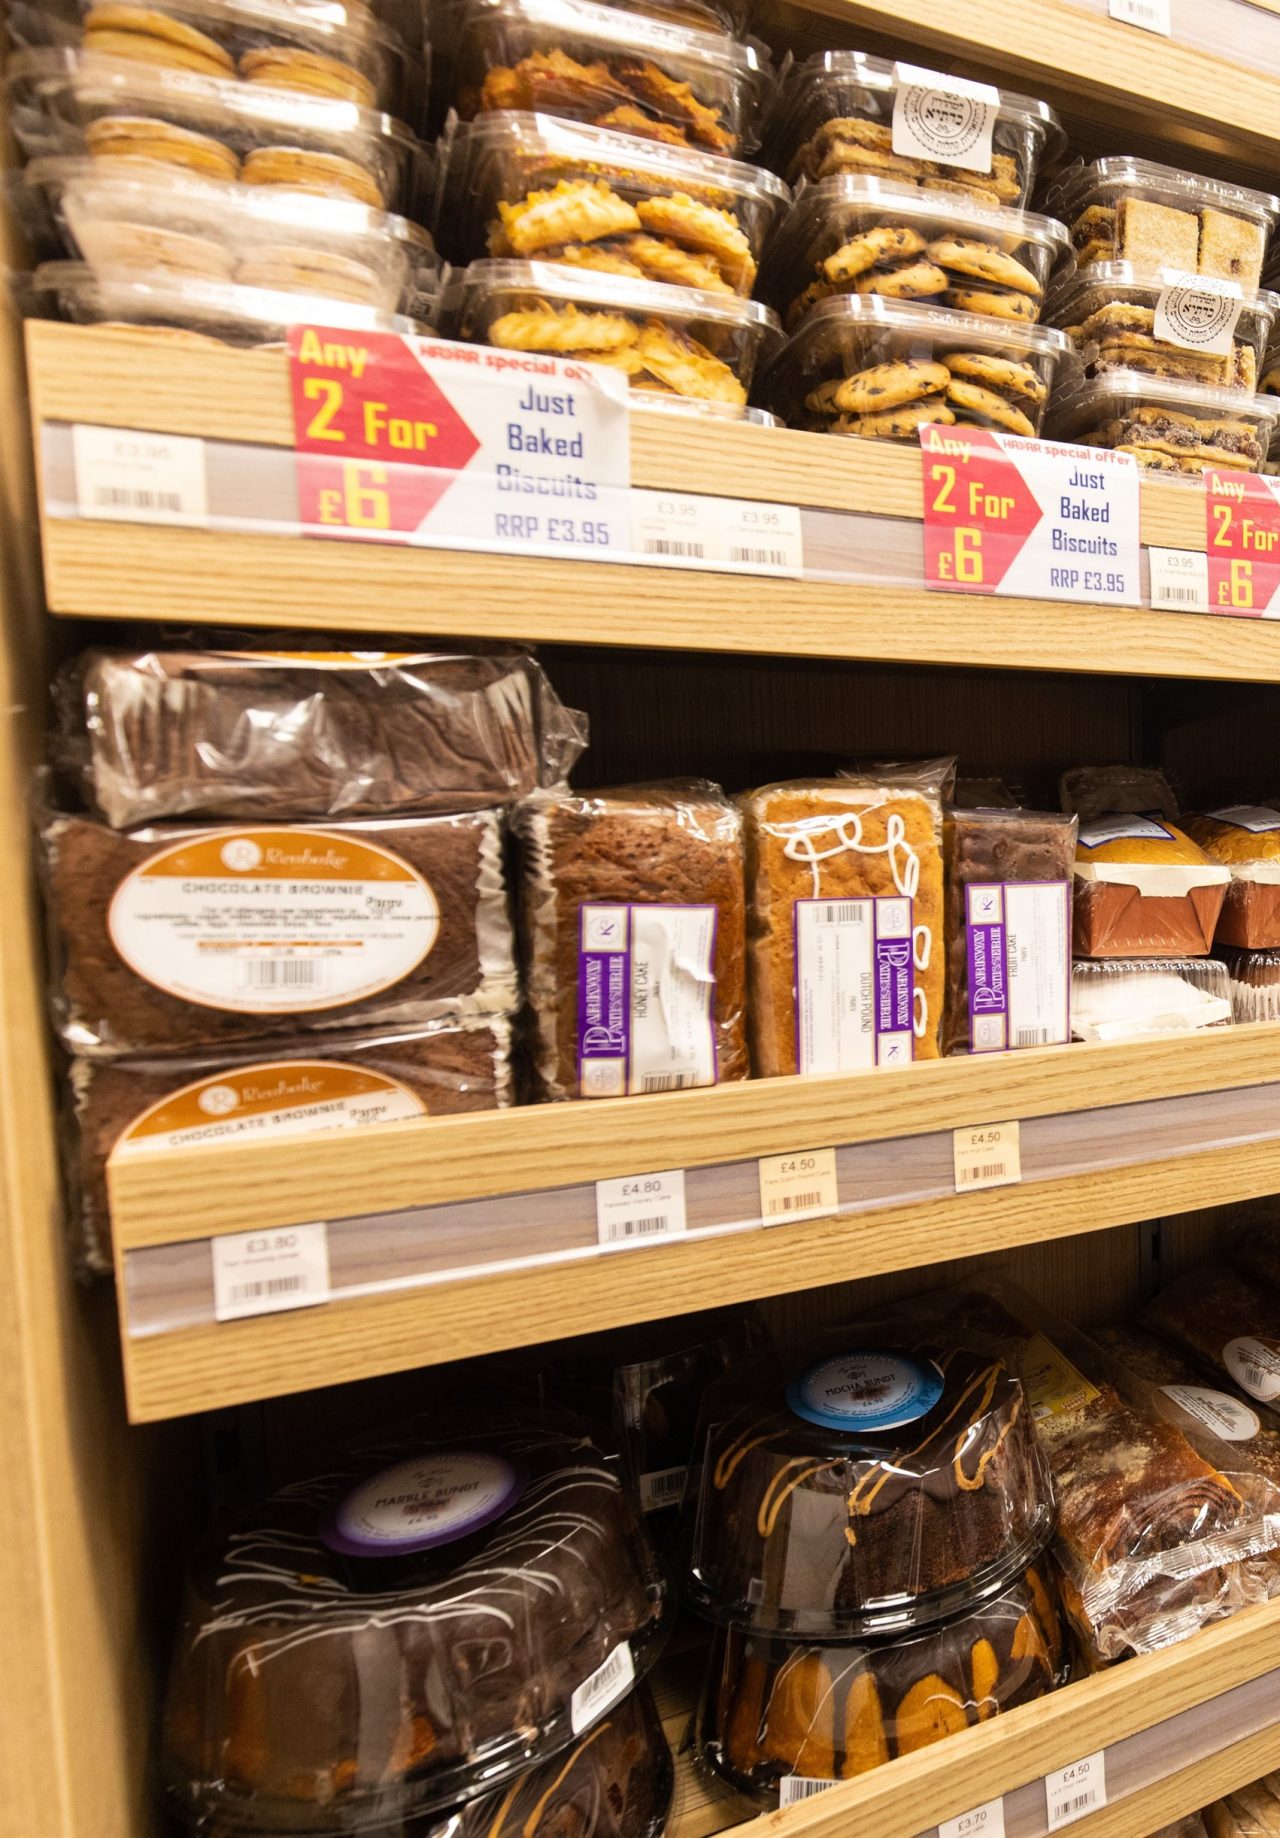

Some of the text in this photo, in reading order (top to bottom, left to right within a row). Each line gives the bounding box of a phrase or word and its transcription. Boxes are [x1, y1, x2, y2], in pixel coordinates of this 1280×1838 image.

[299, 329, 368, 378] Any
[485, 354, 556, 377] special
[303, 377, 438, 450] 2 For
[519, 384, 576, 416] Just
[507, 423, 584, 458] Baked
[929, 429, 972, 464] Any
[1044, 445, 1091, 461] special
[1095, 452, 1130, 466] offer
[318, 461, 391, 530] £6
[496, 464, 598, 500] Biscuits
[932, 465, 1016, 519] 2 For
[1069, 466, 1105, 490] Just
[1212, 474, 1245, 503] Any
[1060, 497, 1110, 523] Baked
[495, 513, 539, 539] RRP
[547, 518, 610, 546] £3.95
[1052, 529, 1118, 556] Biscuits
[1213, 505, 1279, 552] 2 For
[938, 527, 984, 583] £6
[1167, 556, 1194, 569] £3.95
[1050, 568, 1125, 593] RRP £3.95
[1218, 559, 1254, 608] £6
[182, 882, 364, 896] CHOCOLATE BROWNIE
[974, 929, 991, 1012] PARKWAY
[990, 927, 1005, 1009] PATISSERIE
[1008, 933, 1018, 978] FRUIT CAKE
[634, 961, 648, 1018] HONEY CAKE
[877, 943, 892, 1030] PATISSERIE
[889, 942, 910, 1027] PARKWAY
[583, 957, 610, 1054] PARKWAY
[608, 956, 626, 1053] PATISSERIE
[860, 972, 873, 1034] DUTCH POUND
[168, 1100, 347, 1146] CHOCOLATE BROWNIE
[971, 1131, 1001, 1145] £4.50
[781, 1158, 815, 1173] £4.50
[622, 1180, 662, 1196] £4.80
[825, 1374, 897, 1397] MOCHA BUNDT
[374, 1481, 480, 1508] MARBLE BUNDT
[1063, 1762, 1090, 1783] £4.50
[958, 1811, 987, 1832] £3.70
